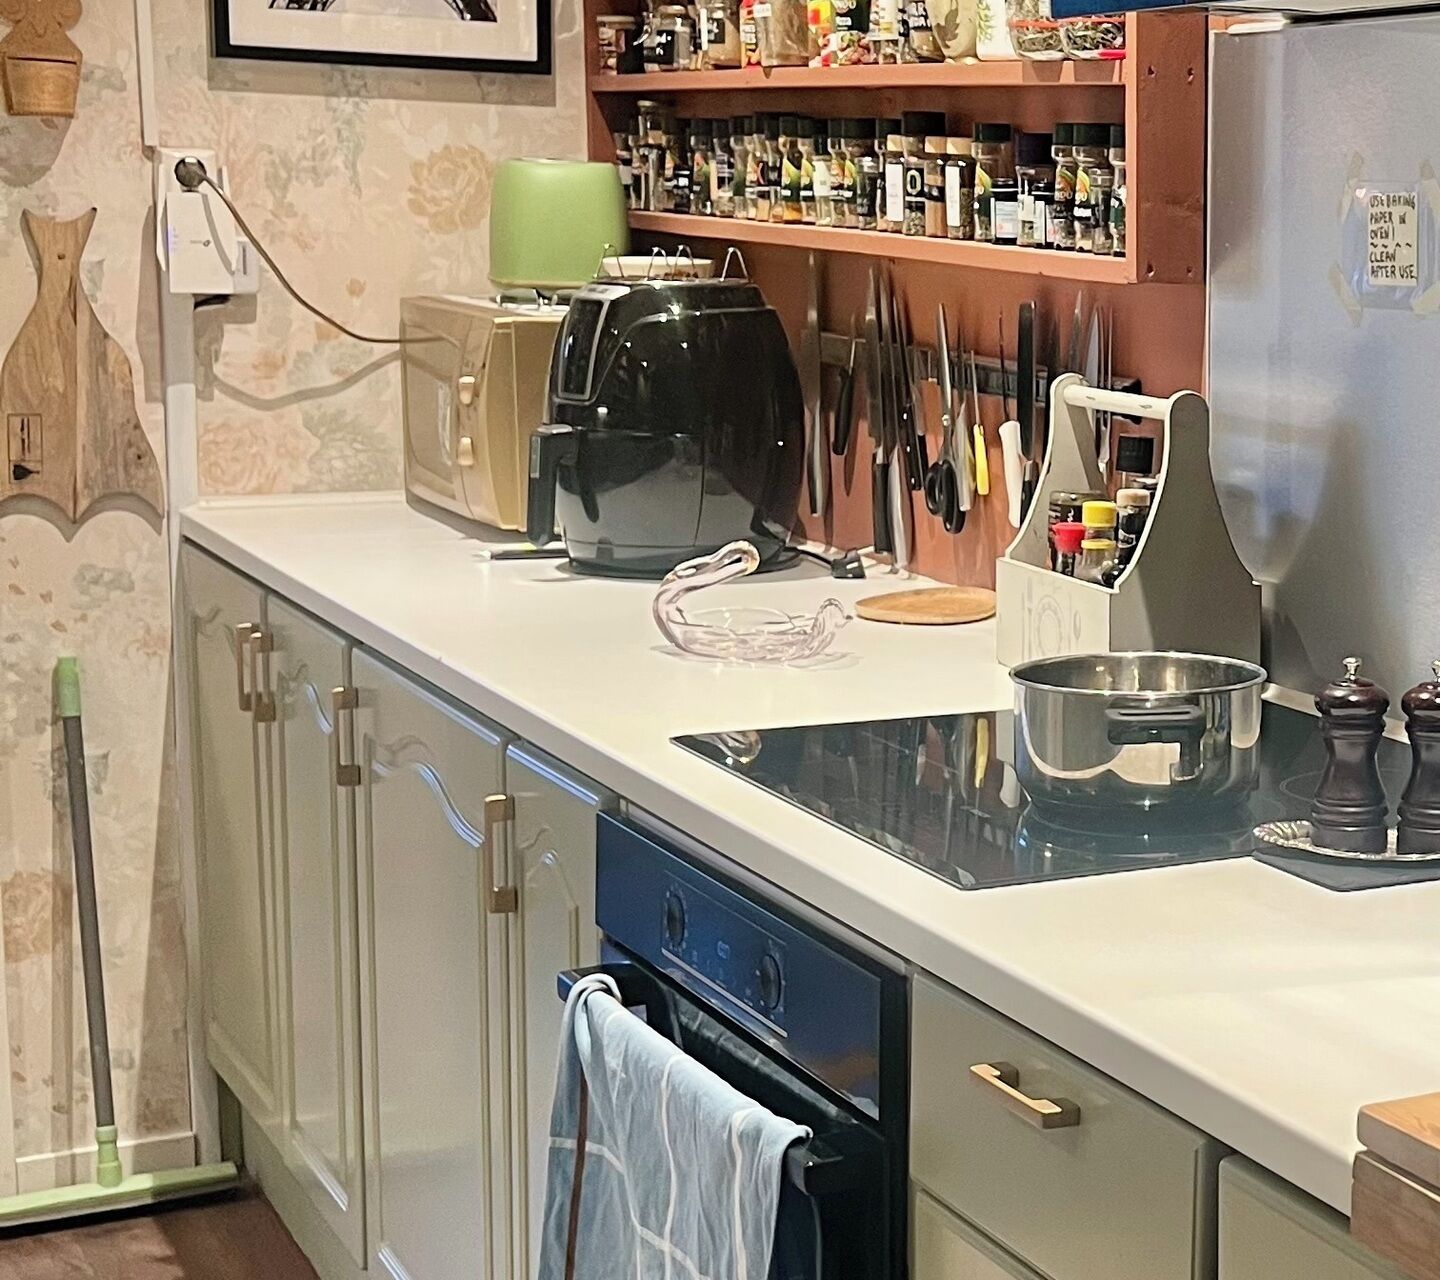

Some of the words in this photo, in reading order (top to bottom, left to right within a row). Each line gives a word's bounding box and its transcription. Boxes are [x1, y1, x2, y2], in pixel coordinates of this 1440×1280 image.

[1370, 195, 1384, 208] USE
[1386, 194, 1415, 210] BAKING
[1370, 211, 1393, 225] PAPER
[1369, 248, 1396, 263] CLEAN
[1371, 265, 1396, 279] AFTER
[1399, 264, 1416, 279] USE
